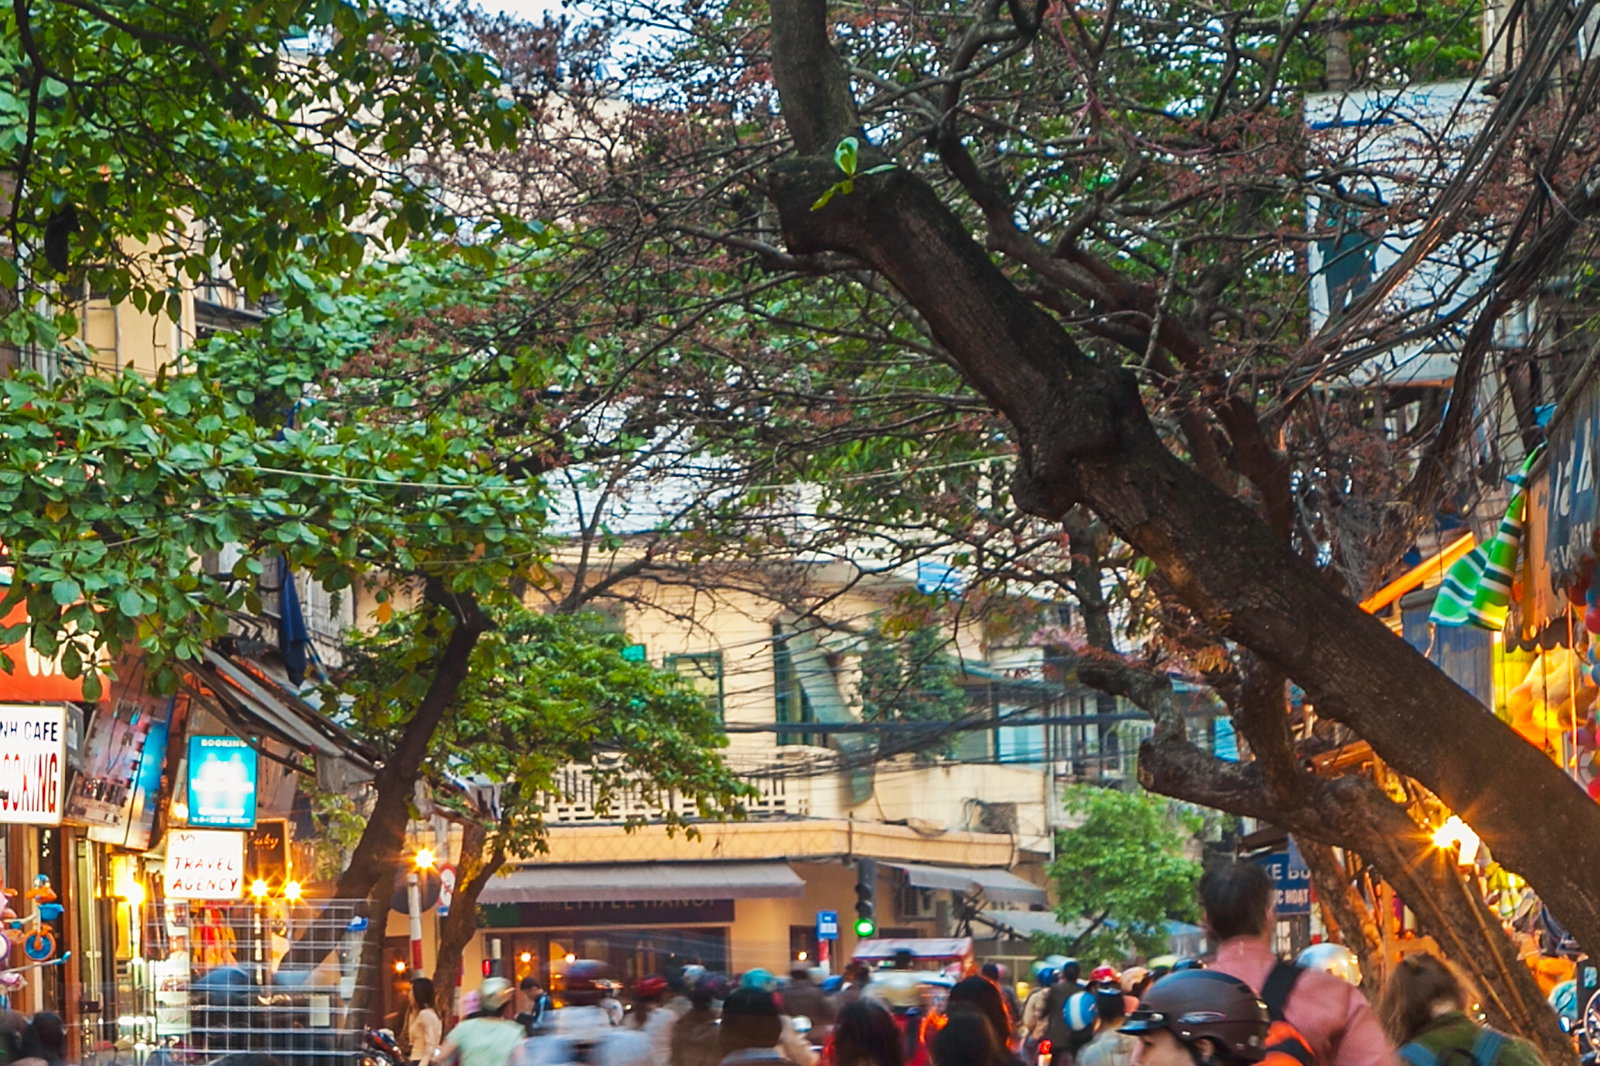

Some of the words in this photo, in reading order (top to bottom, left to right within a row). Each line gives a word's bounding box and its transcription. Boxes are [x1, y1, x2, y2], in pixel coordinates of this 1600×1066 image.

[24, 721, 58, 742] CAFE
[201, 738, 248, 748] BOOKING
[174, 856, 234, 871] TRAVEL
[172, 878, 239, 892] AGENCY
